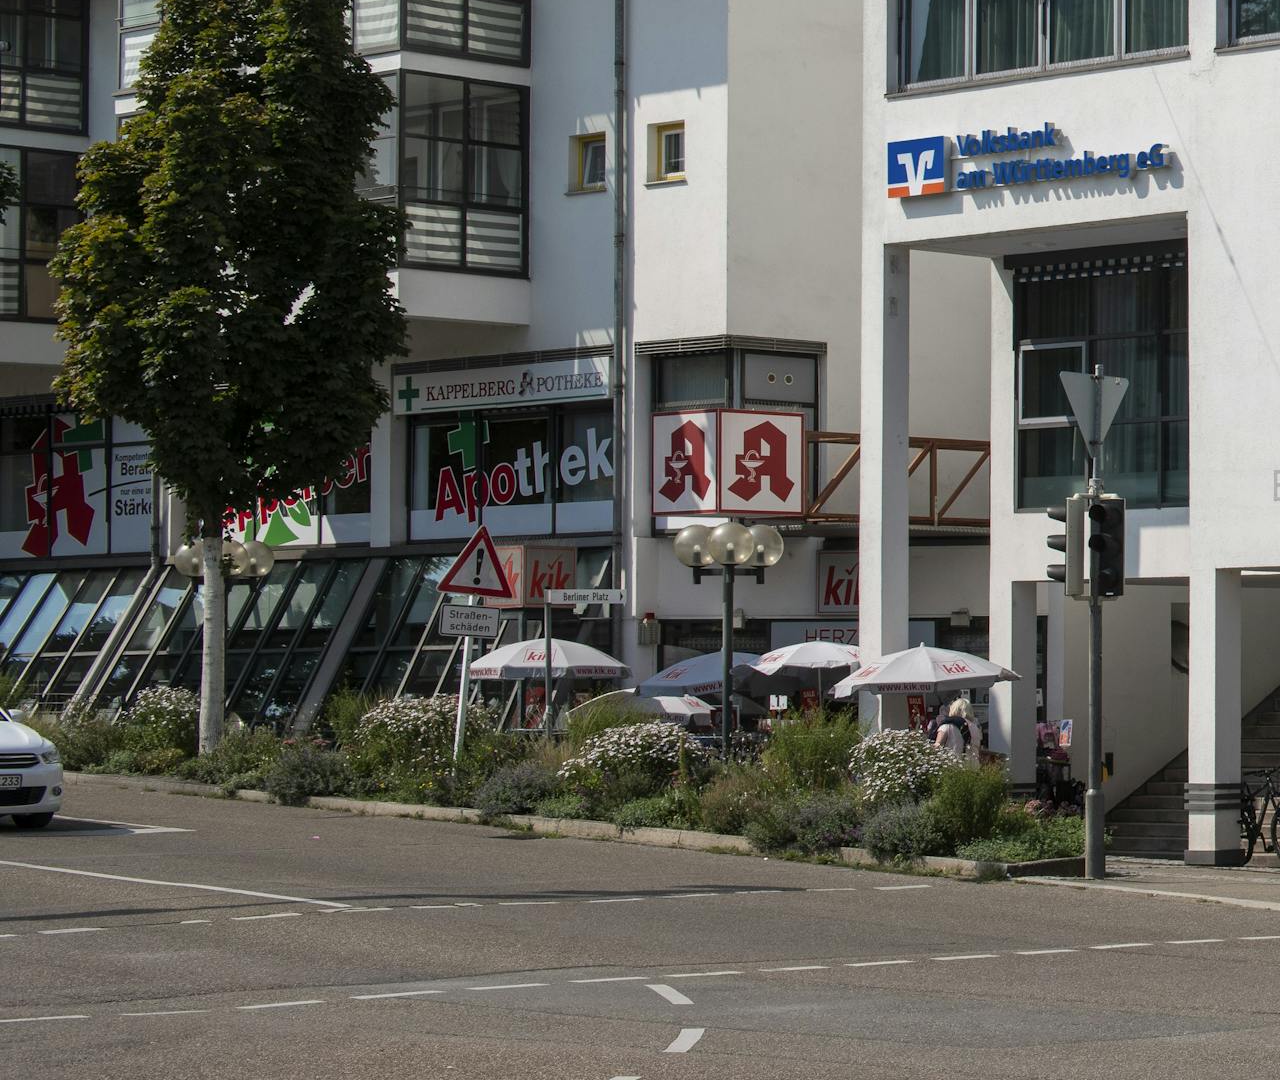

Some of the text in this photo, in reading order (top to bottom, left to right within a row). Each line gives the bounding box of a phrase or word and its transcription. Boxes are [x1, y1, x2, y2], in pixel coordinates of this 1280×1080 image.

[956, 122, 1056, 156] Volksbank
[957, 143, 1167, 189] am Württemberg eG
[426, 379, 516, 402] KAPPELBERG
[530, 553, 571, 598] kik
[824, 563, 859, 606] ki
[563, 592, 609, 602] Berliner Platz
[449, 609, 493, 621] Straßen-
[449, 622, 490, 633] schäden
[527, 650, 546, 661] ki
[942, 662, 969, 675] kik
[876, 683, 932, 693] www.kik.eu
